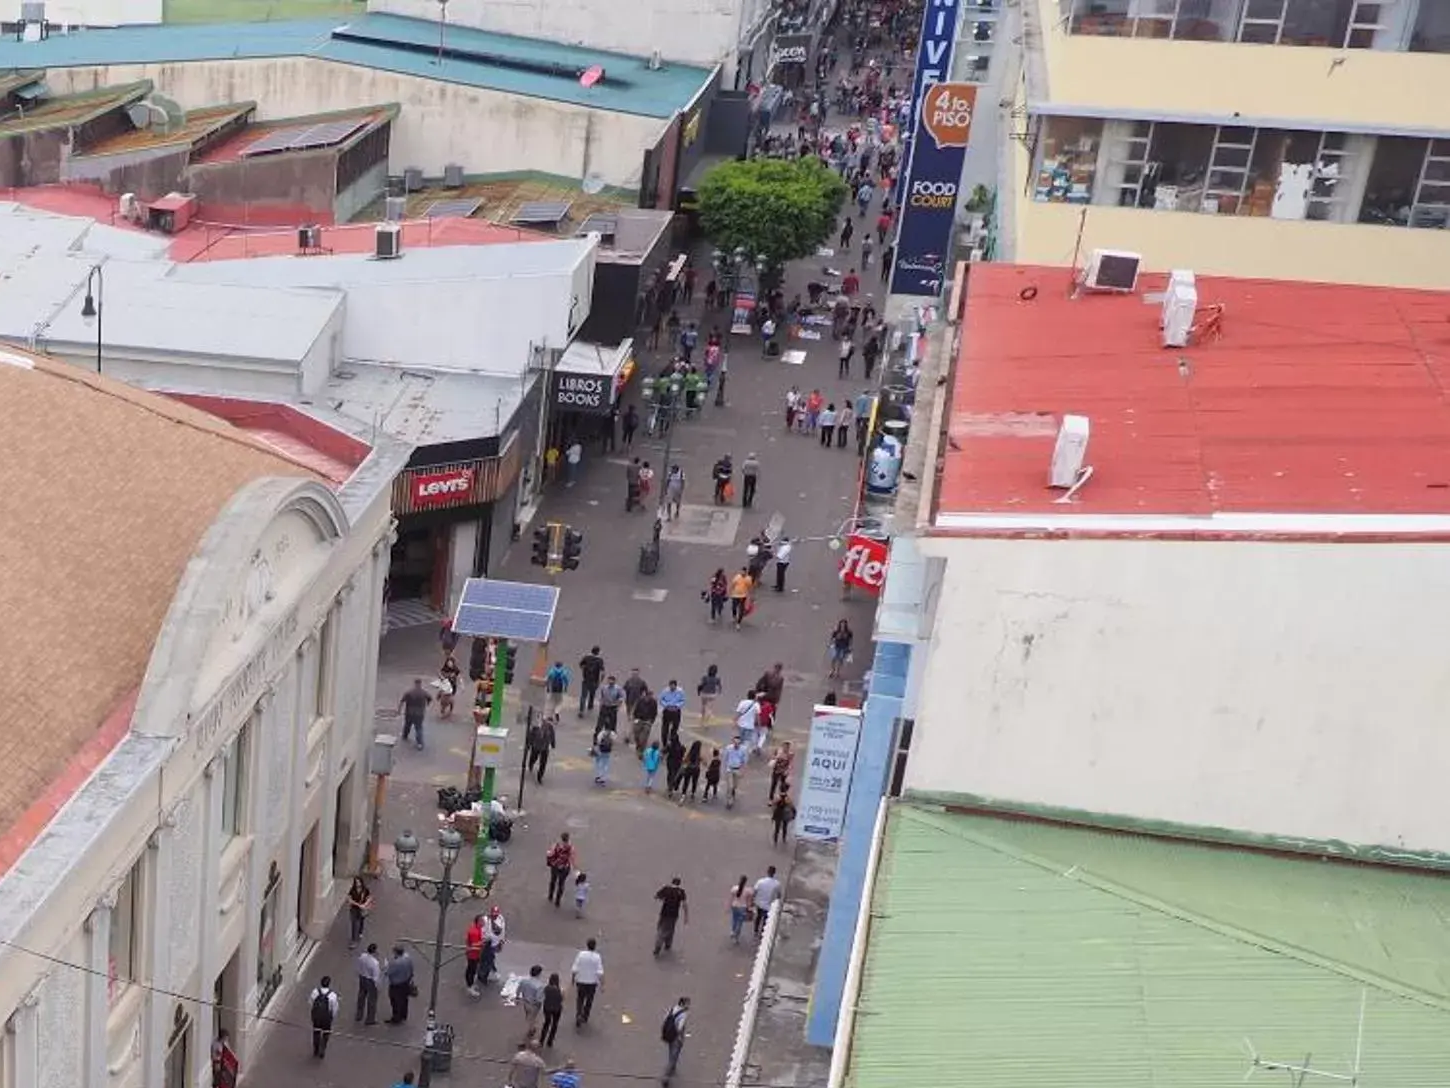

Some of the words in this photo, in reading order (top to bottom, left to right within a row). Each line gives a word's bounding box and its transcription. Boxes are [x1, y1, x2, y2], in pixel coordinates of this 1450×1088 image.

[932, 110, 971, 127] PISO
[911, 181, 956, 196] FOOD
[909, 194, 954, 208] COURT
[558, 376, 603, 393] LIBROS
[557, 391, 601, 407] BOOKS
